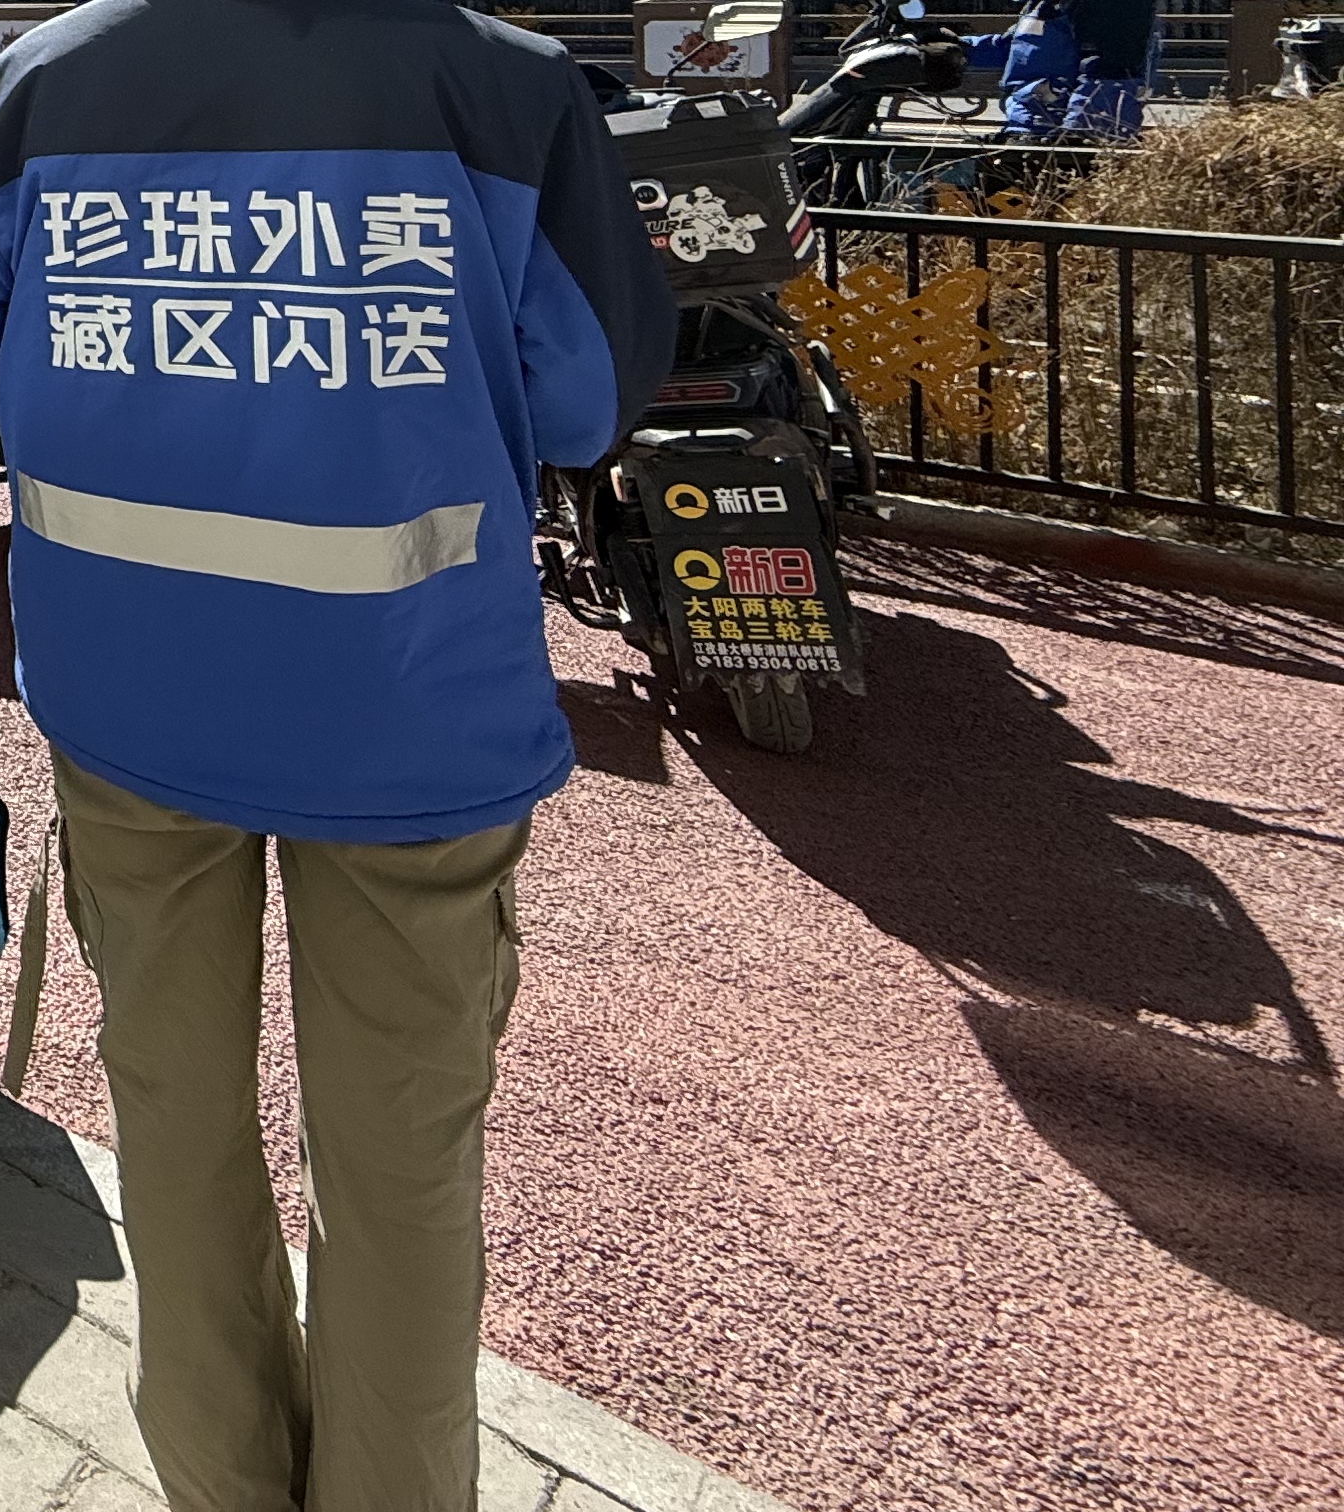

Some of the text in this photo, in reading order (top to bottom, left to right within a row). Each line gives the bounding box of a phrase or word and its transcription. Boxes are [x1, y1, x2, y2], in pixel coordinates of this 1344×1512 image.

[40, 190, 454, 279] 珍珠外卖
[47, 294, 450, 390] 藏区闪送
[712, 486, 788, 514] 新日
[722, 546, 817, 596] 新日
[683, 596, 828, 619] 大阳两轮车
[687, 619, 834, 642] 宝岛三轮车
[713, 656, 745, 669] 183
[747, 657, 793, 670] 9304
